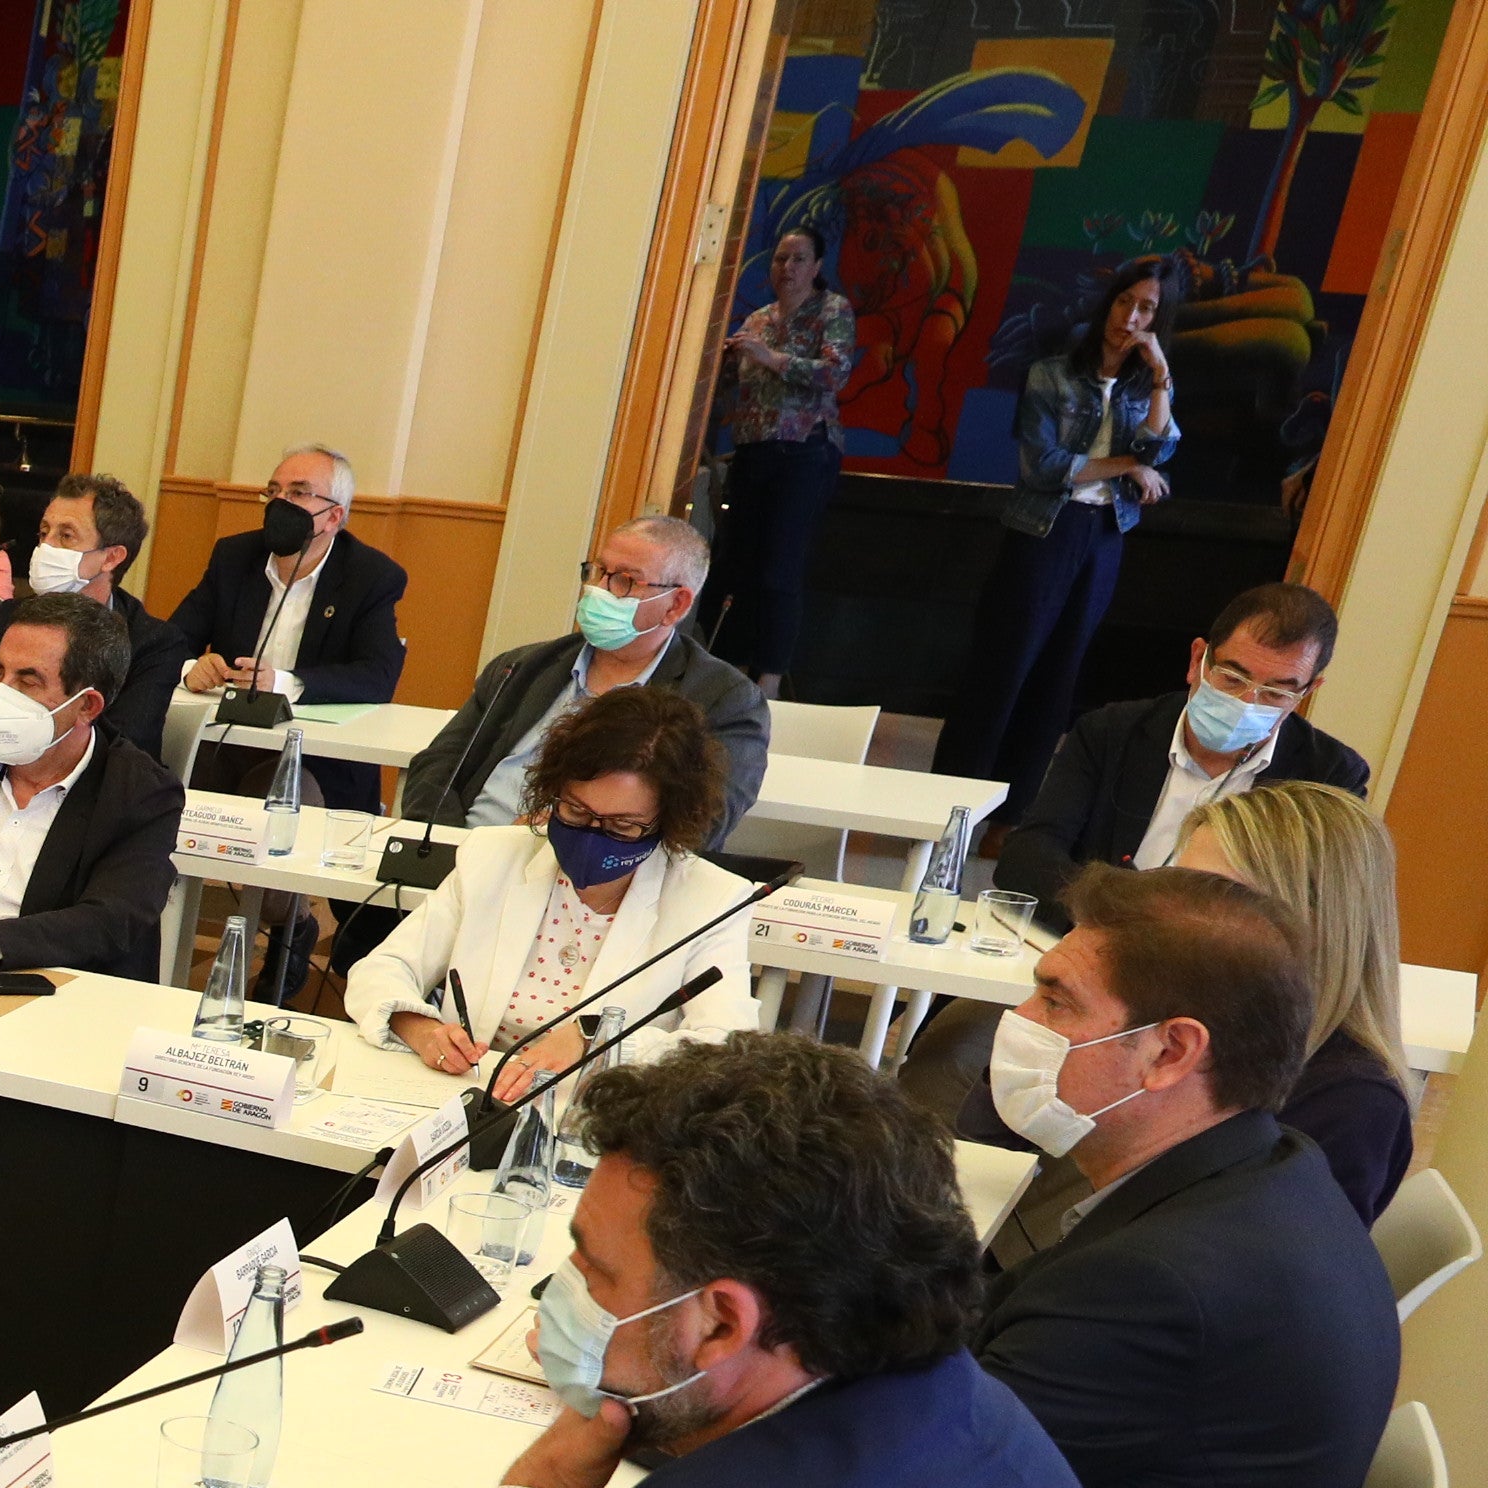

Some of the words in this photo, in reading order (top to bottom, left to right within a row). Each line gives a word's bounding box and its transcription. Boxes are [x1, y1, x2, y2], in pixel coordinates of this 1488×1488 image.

[181, 809, 217, 821] NTEAGUDO
[783, 898, 821, 911] CODURAS
[755, 924, 770, 937] 21
[166, 1046, 206, 1063] ALBAJEZ
[208, 1055, 249, 1072] BELTRÁN
[138, 1077, 149, 1092] 9
[233, 1101, 268, 1113] GOBIERNO
[243, 1109, 272, 1121] ARAGON
